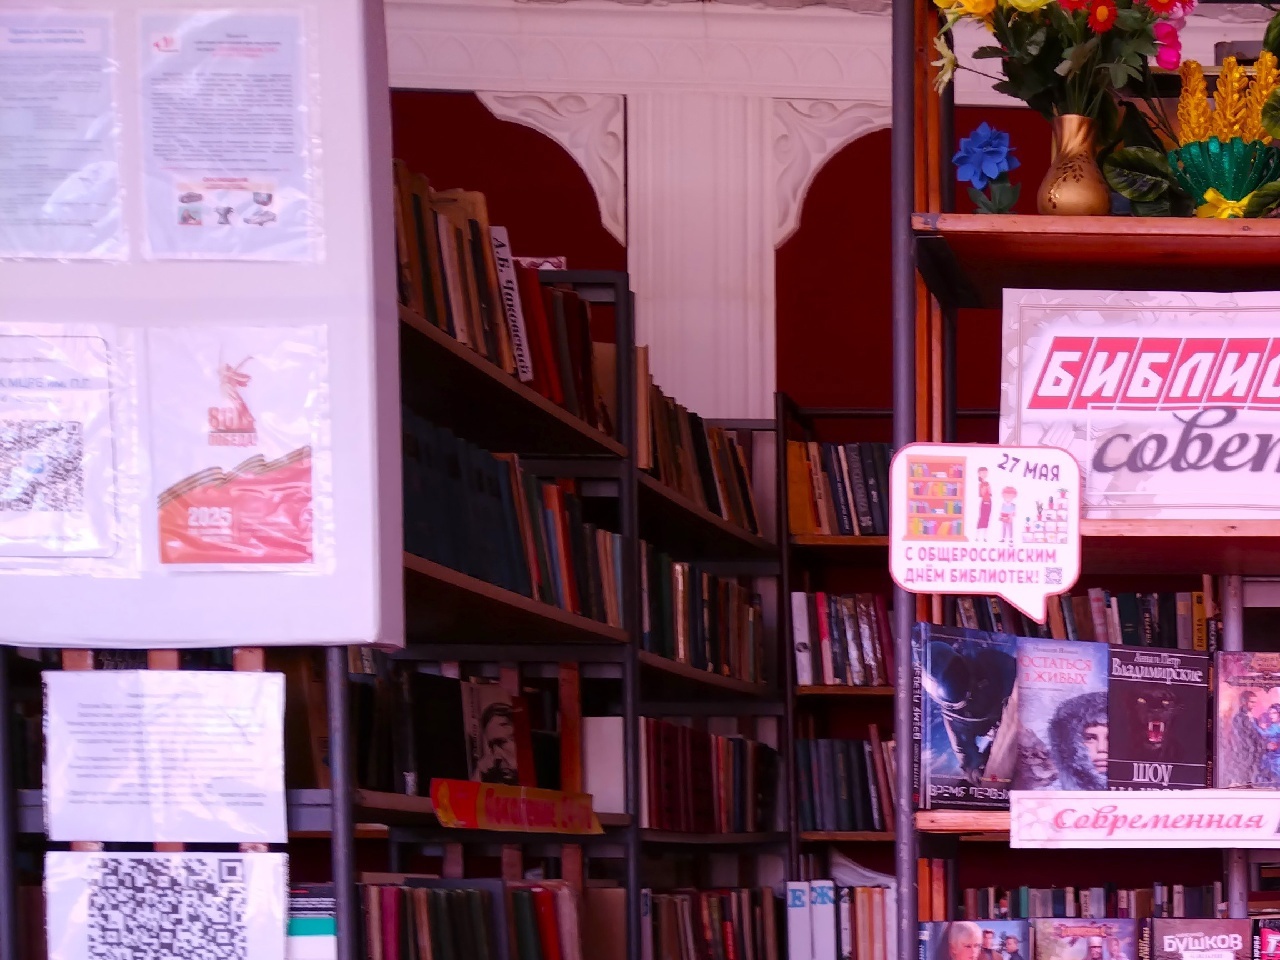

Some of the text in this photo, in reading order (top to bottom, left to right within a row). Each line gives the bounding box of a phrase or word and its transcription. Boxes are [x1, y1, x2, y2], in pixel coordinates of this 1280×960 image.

[997, 453, 1060, 482] 27 МАЯ
[187, 506, 233, 528] 2025
[905, 543, 1057, 563] С ОБЩЕРОССИЙСКИМ
[904, 564, 1040, 584] ДНЁМ БИБЛИОТЕК!
[1018, 655, 1094, 673] ОСТАТЬСЯ
[1111, 658, 1204, 684] Владимирские
[1033, 671, 1088, 686] ЖИВЫХ
[1132, 762, 1174, 786] ШОУ
[1053, 804, 1265, 837] Современная
[788, 888, 806, 908] Е
[810, 885, 835, 905] Ж
[1162, 931, 1243, 952] БУШКОВ
